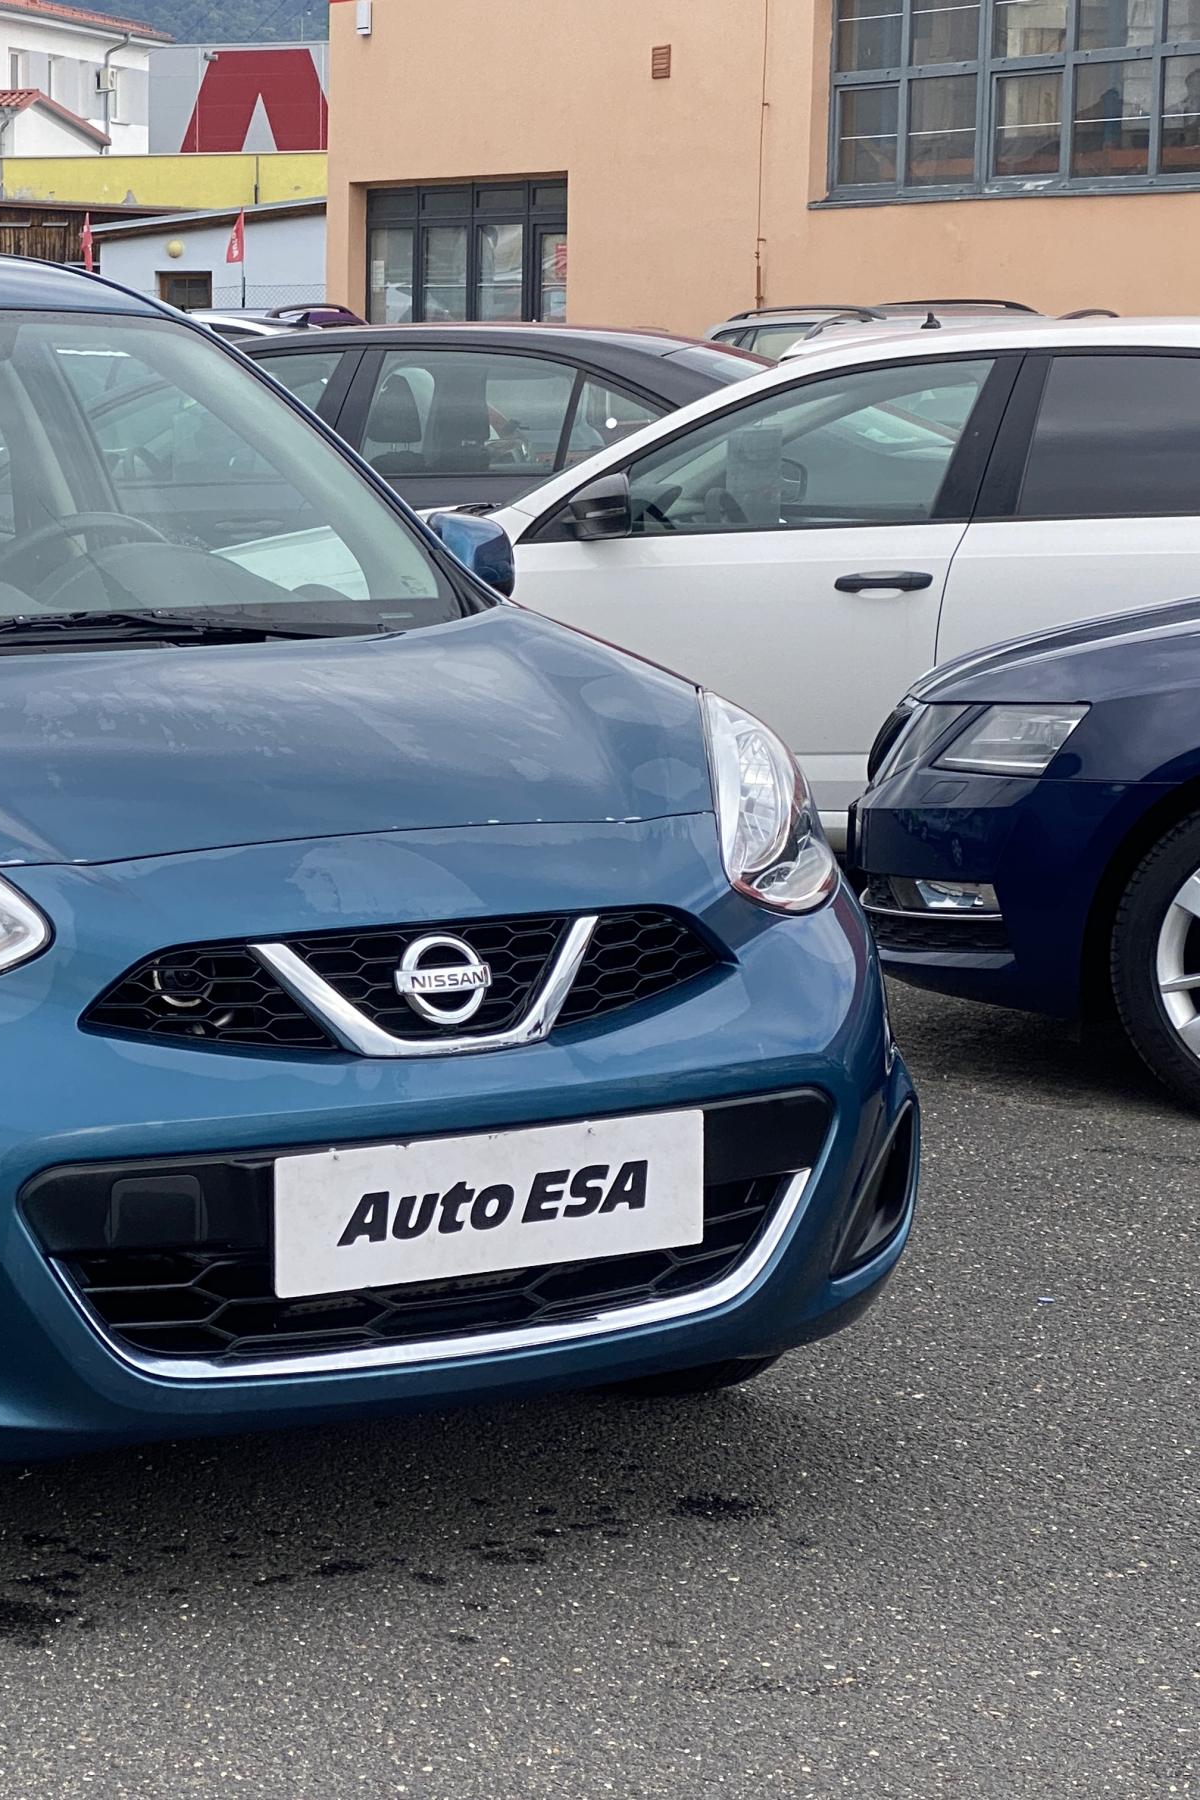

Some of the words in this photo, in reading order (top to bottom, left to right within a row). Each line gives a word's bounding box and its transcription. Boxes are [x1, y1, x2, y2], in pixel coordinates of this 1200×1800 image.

[410, 971, 484, 988] NISSAN
[336, 1181, 515, 1247] Auto
[521, 1159, 648, 1223] ESA
